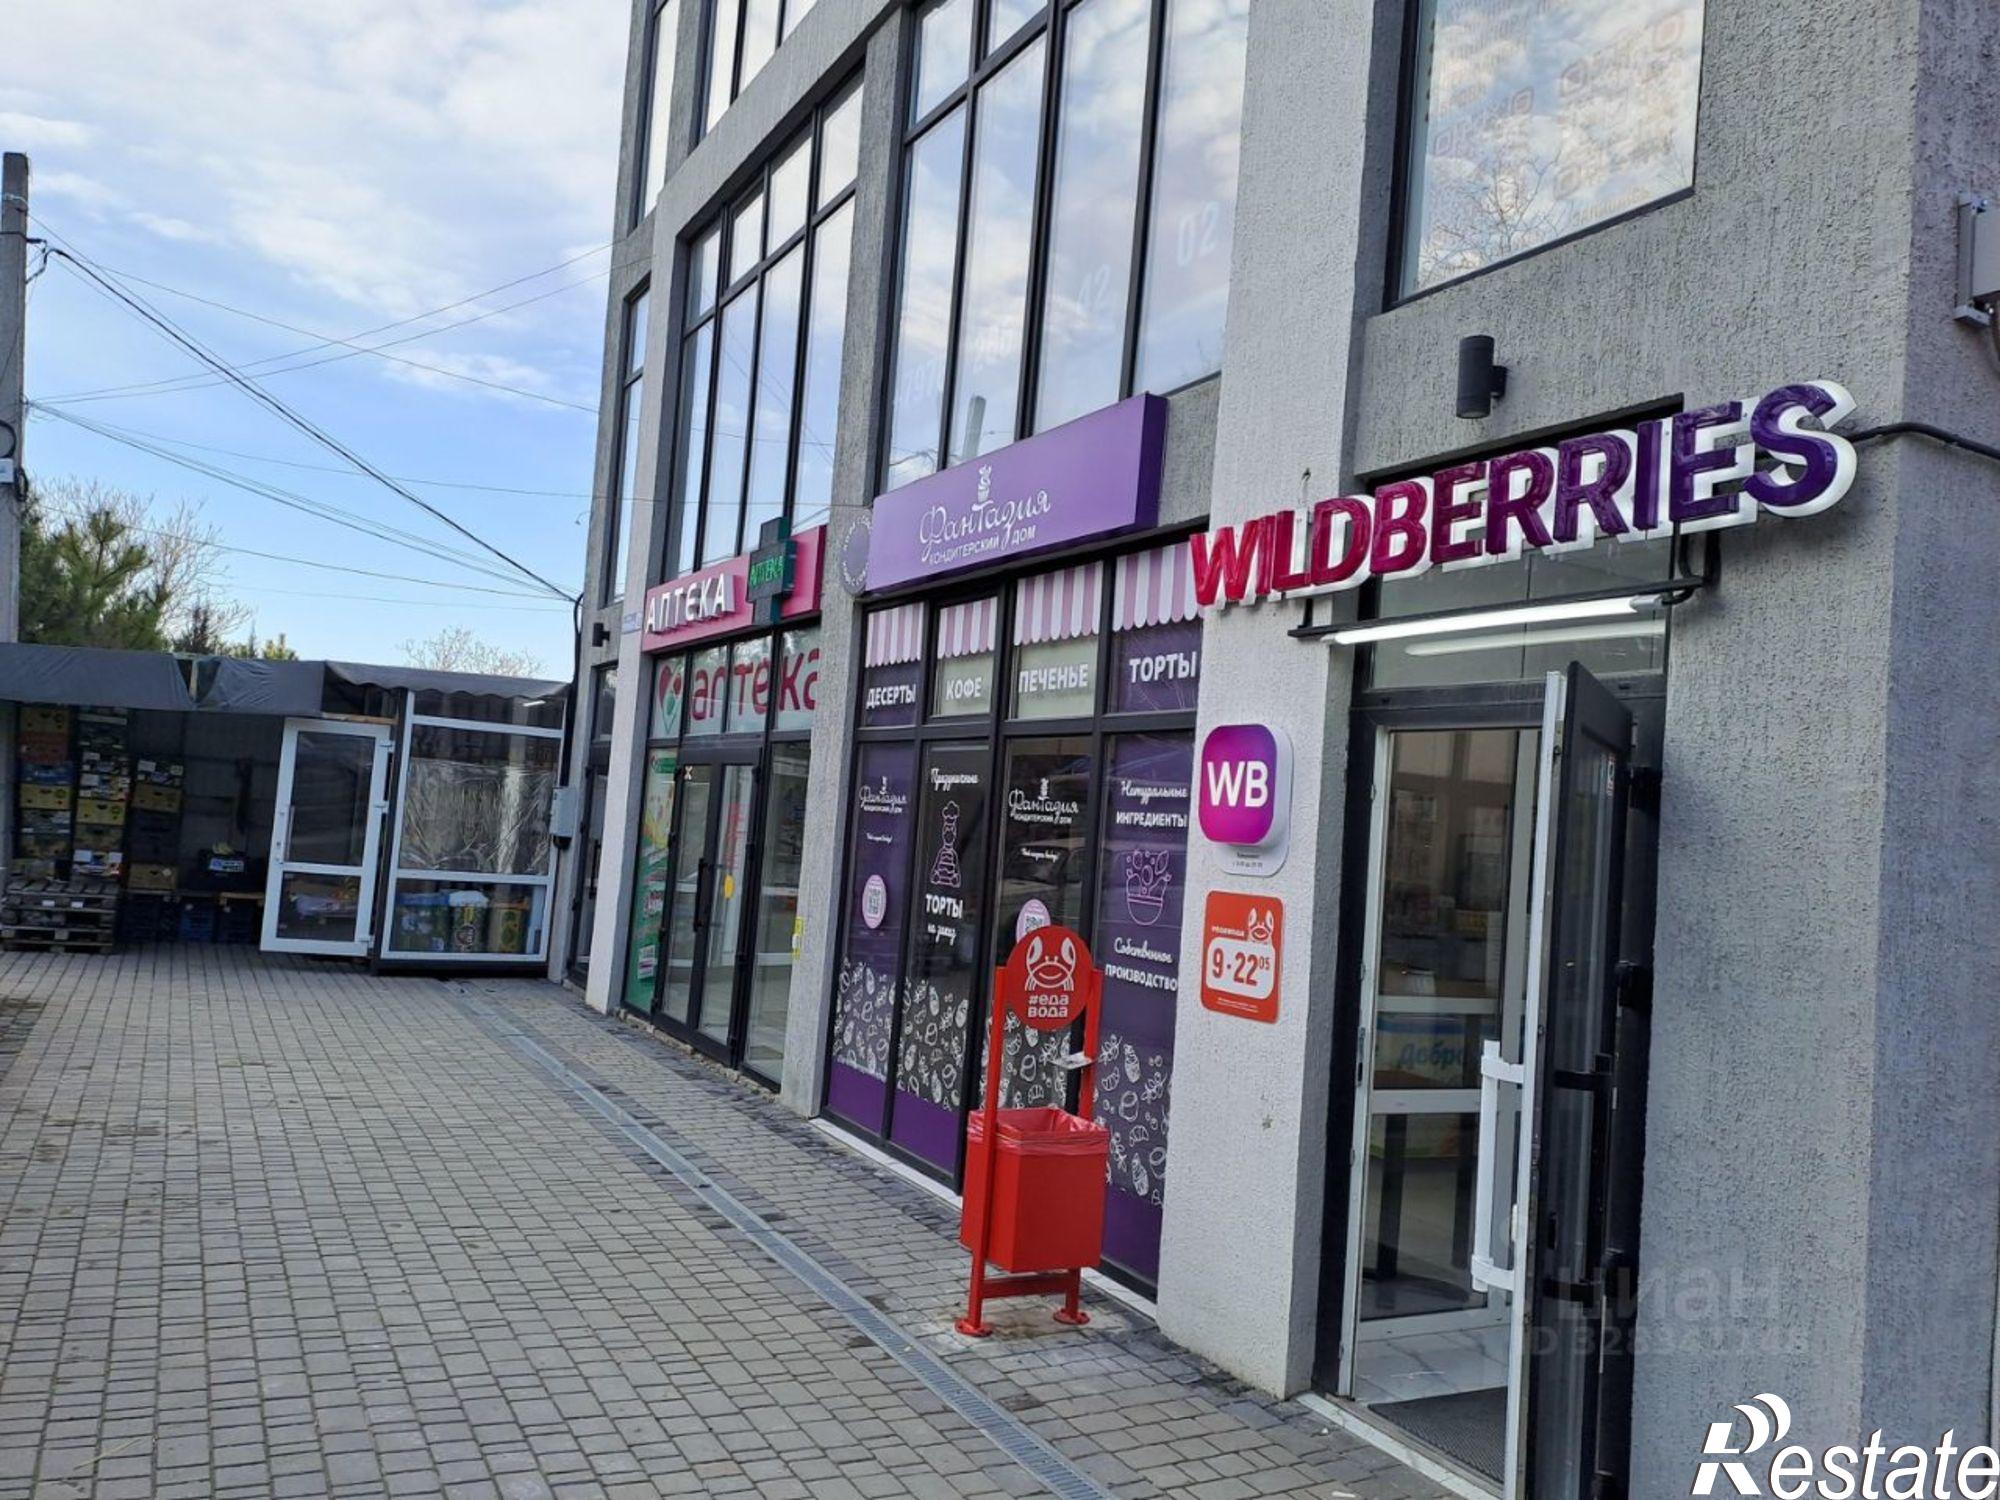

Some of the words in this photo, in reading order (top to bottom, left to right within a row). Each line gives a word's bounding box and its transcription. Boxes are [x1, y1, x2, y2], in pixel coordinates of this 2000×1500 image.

[1189, 380, 1858, 609] WILDBERRIES
[920, 489, 1052, 562] Фантазия
[1011, 525, 1036, 545] ДОМ
[1018, 663, 1090, 694] ПЕЧЕНЬЕ
[1129, 651, 1197, 685] ТОРТЫ
[866, 682, 917, 711] ДЕСЕРТЫ
[946, 675, 984, 702] КОФЕ
[1206, 758, 1270, 809] WB
[1116, 810, 1188, 828] ИНГРЕДИЕНТЫ
[925, 893, 964, 919] ТОРТЫ
[1104, 963, 1179, 992] ПРОИЗВОДСТВО
